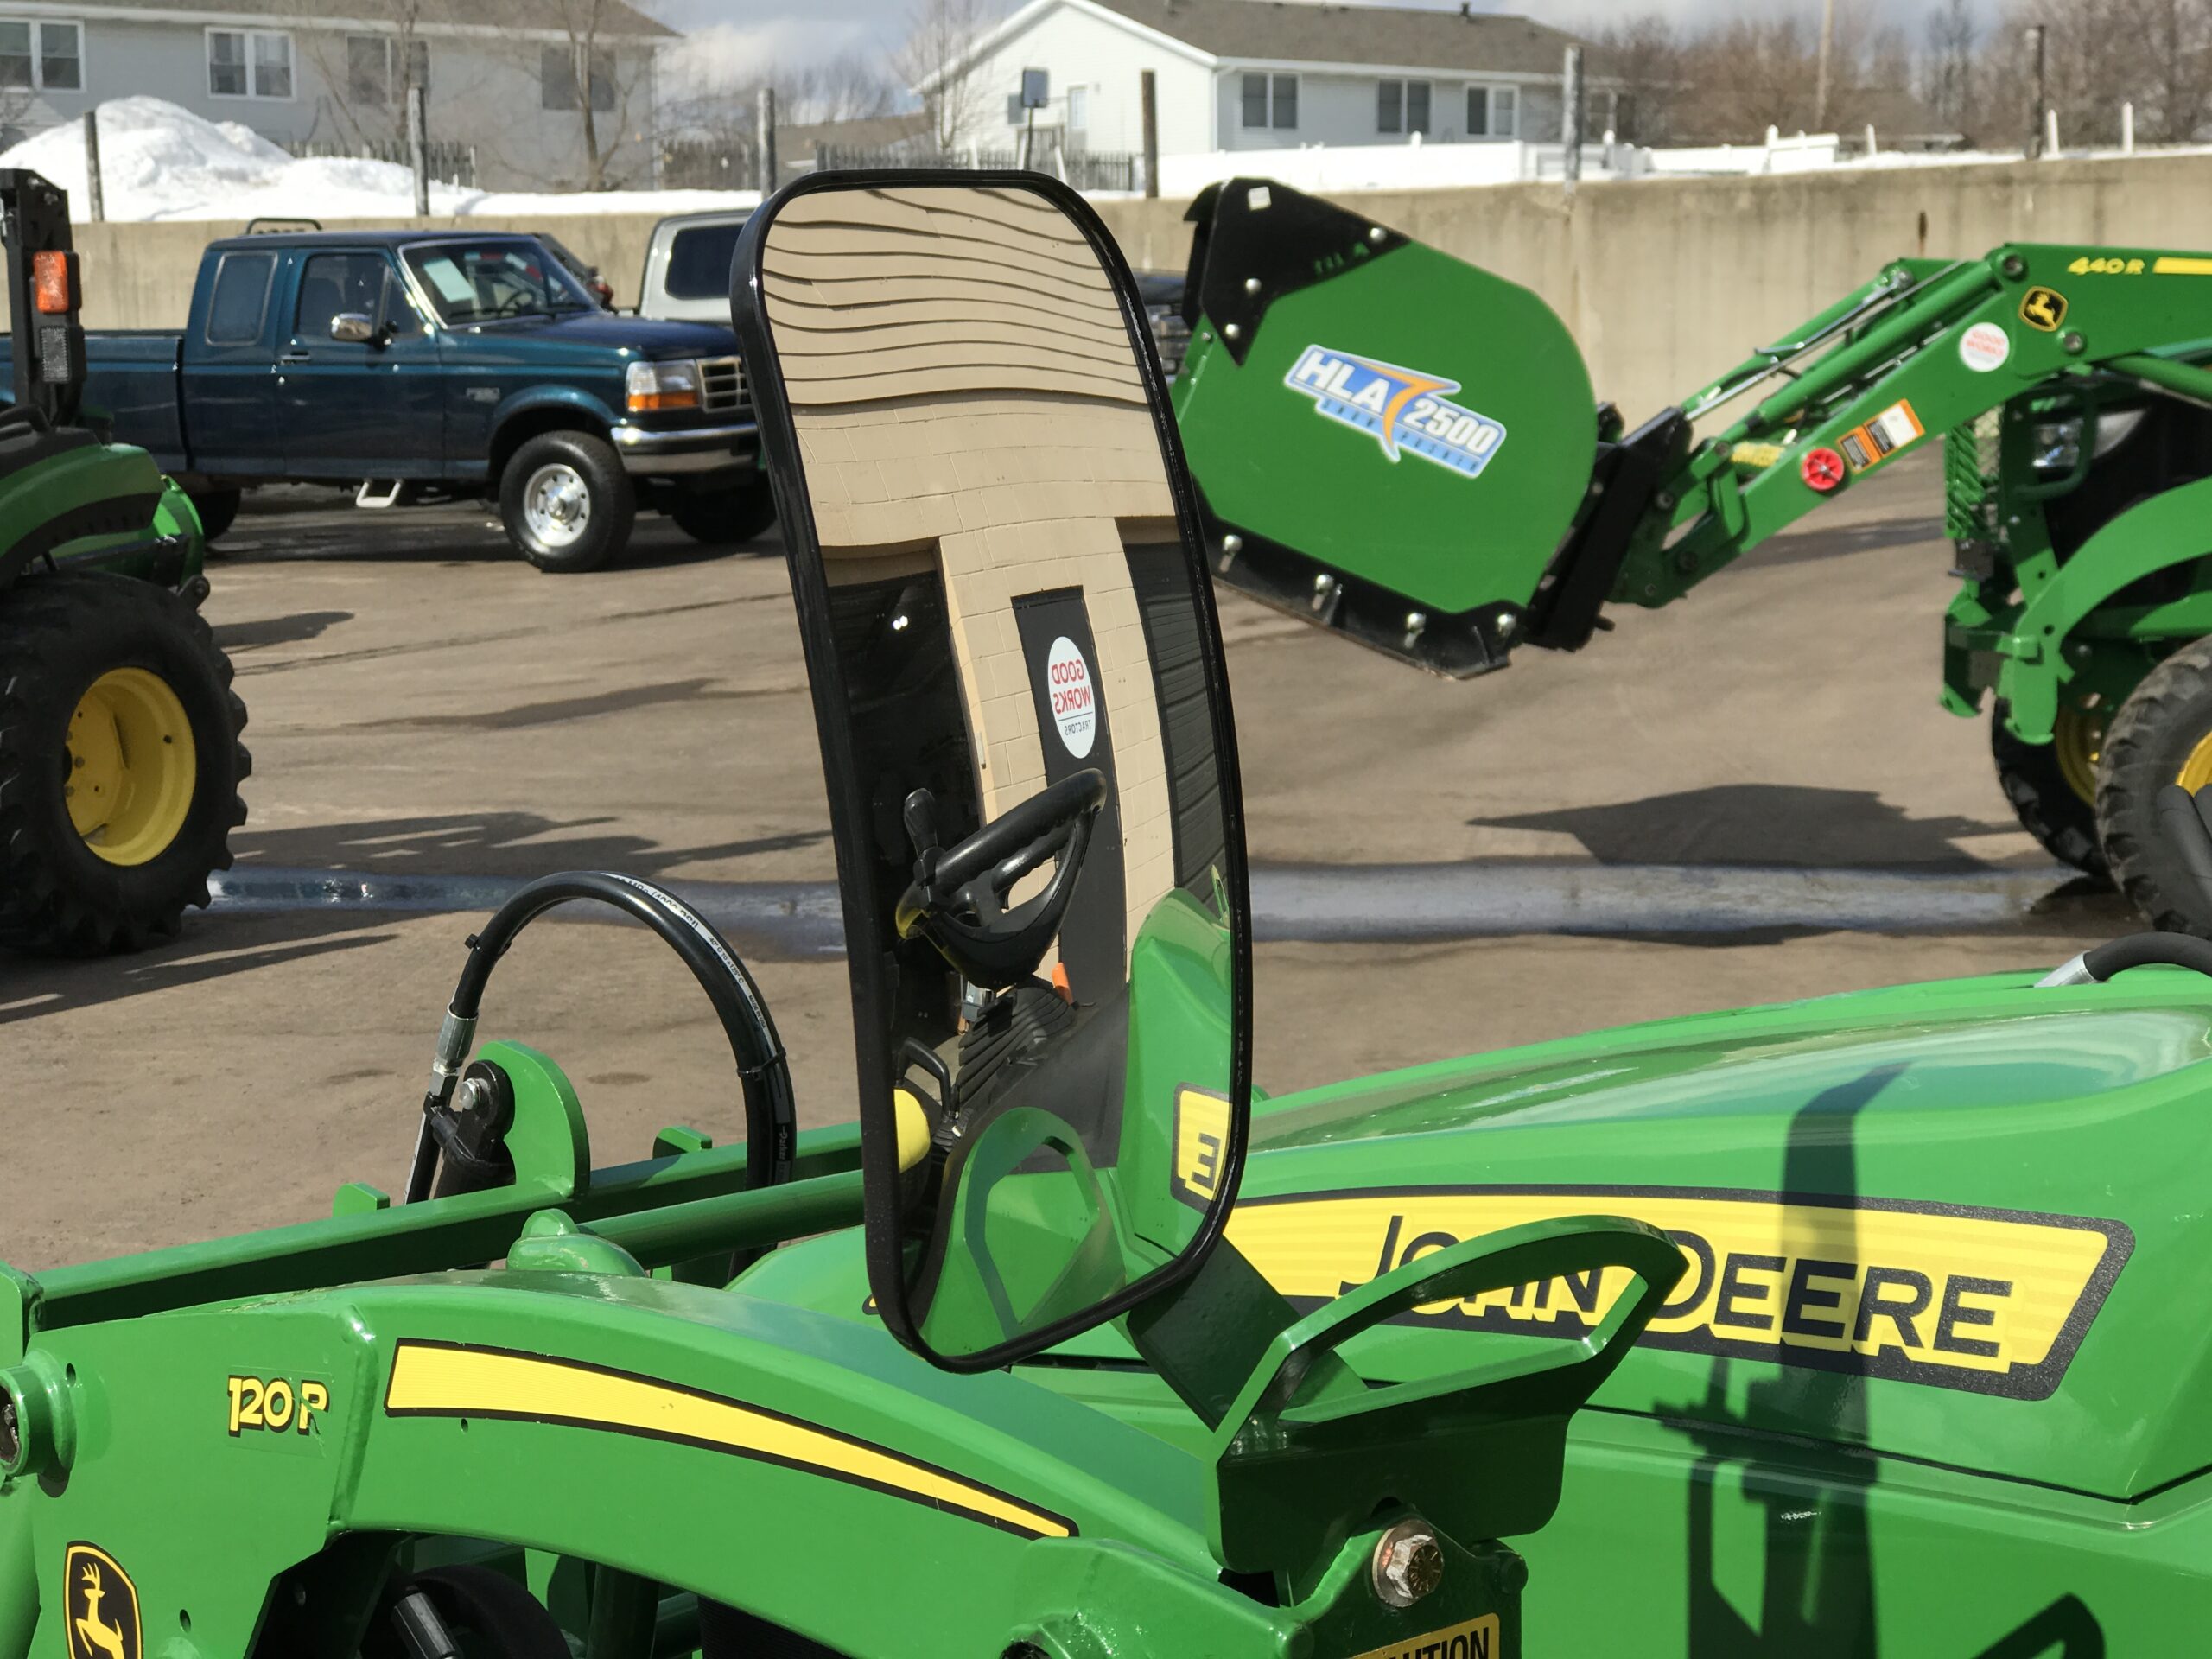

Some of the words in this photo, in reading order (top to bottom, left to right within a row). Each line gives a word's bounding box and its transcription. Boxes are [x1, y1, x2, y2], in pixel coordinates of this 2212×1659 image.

[2066, 257, 2145, 276] 440R
[1295, 351, 1391, 416] HLA
[1403, 397, 1500, 455] 2500
[748, 995, 759, 1011] MADE
